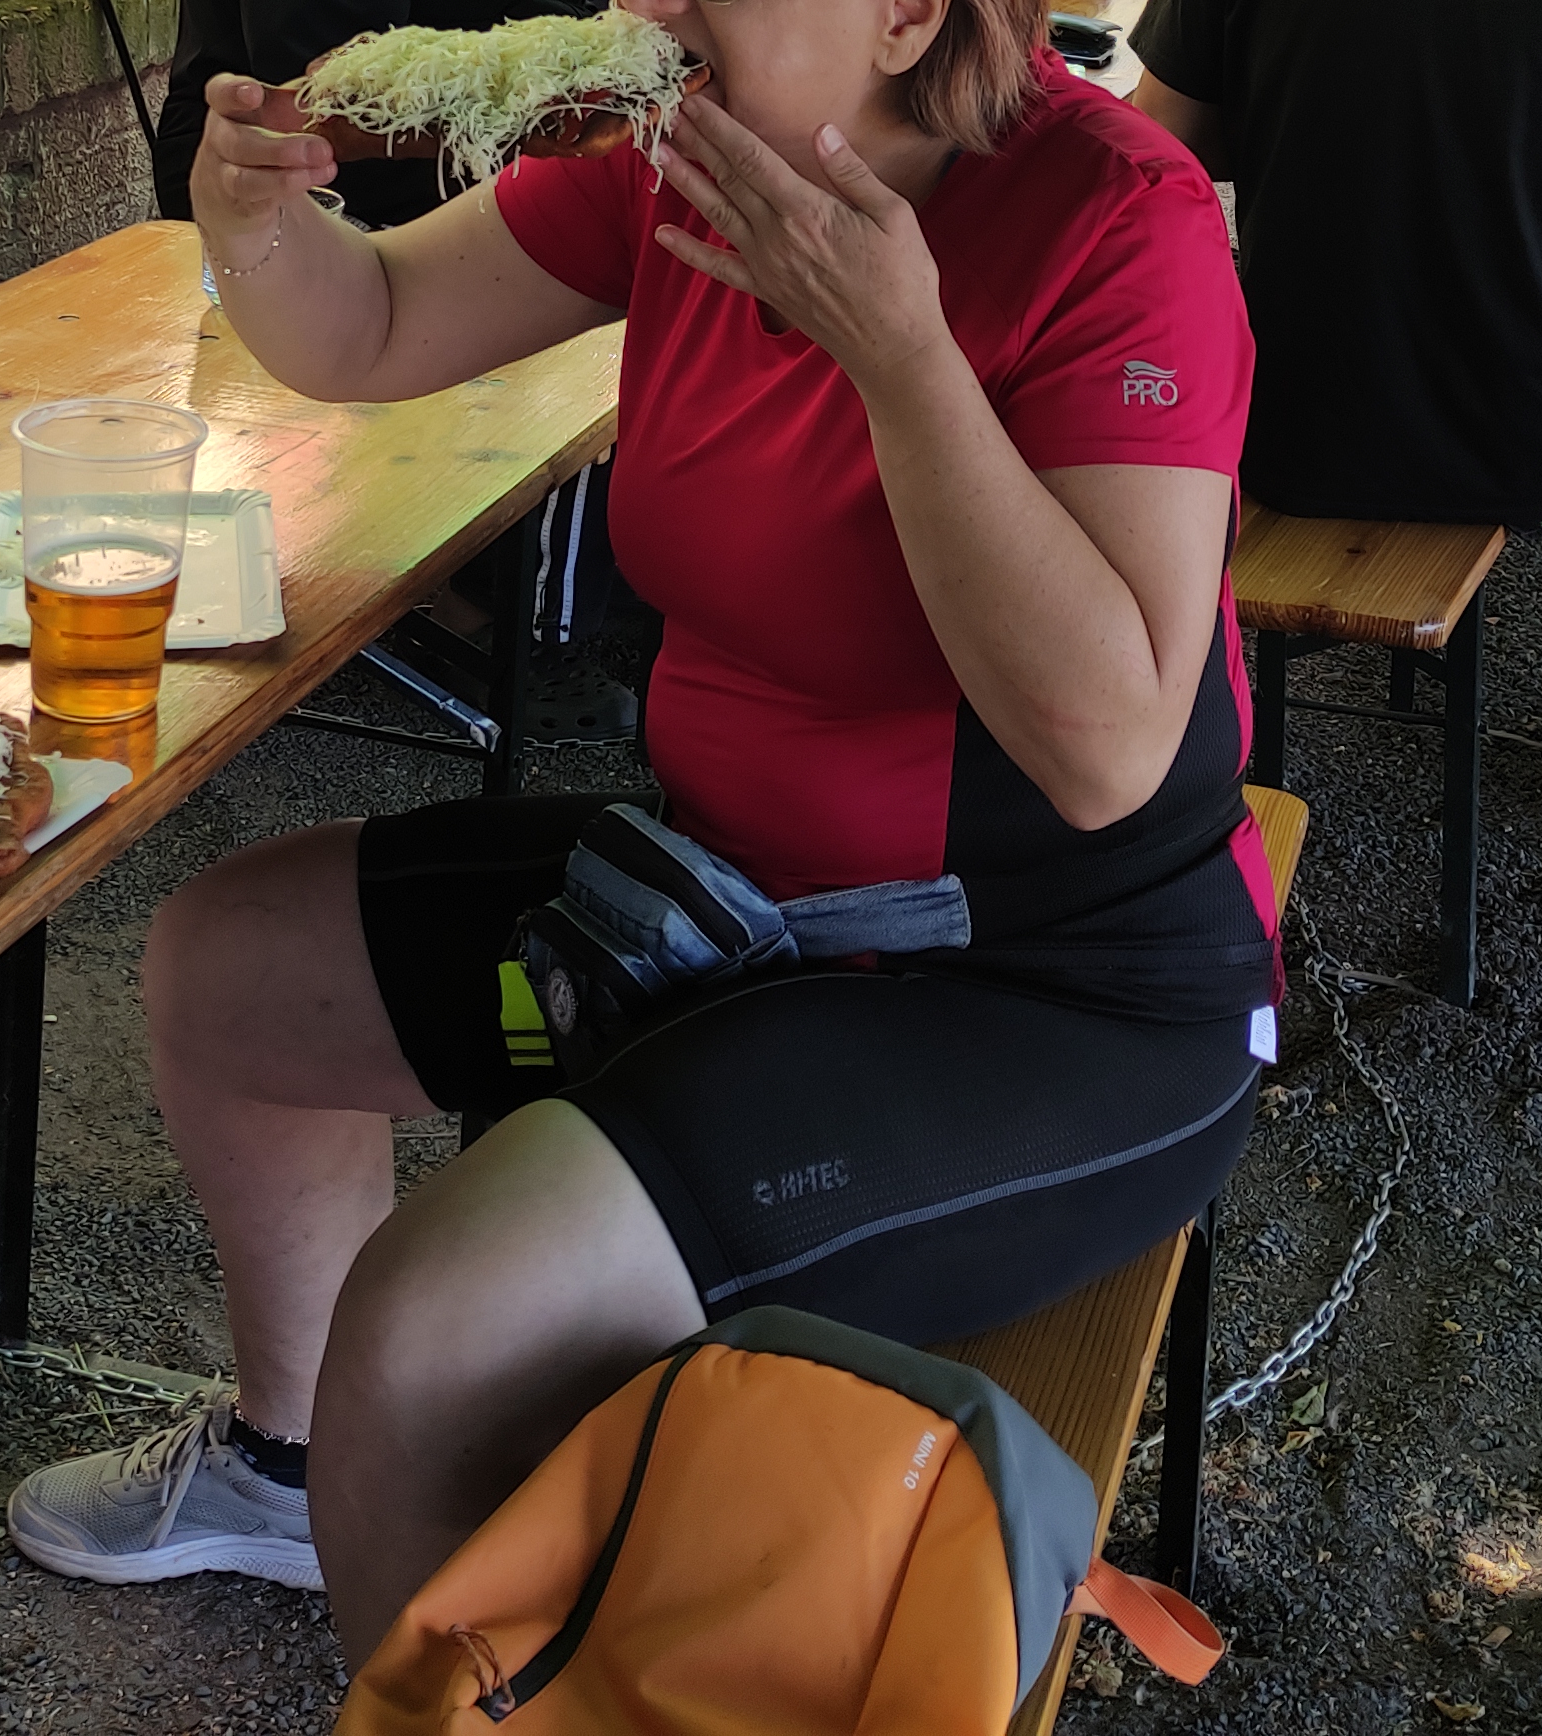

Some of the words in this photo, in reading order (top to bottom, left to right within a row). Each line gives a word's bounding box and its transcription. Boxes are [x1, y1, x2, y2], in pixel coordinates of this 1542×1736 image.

[1122, 378, 1179, 406] PRO
[780, 1158, 851, 1202] HI-TEC
[912, 1430, 937, 1469] MINI
[903, 1468, 920, 1491] 10
